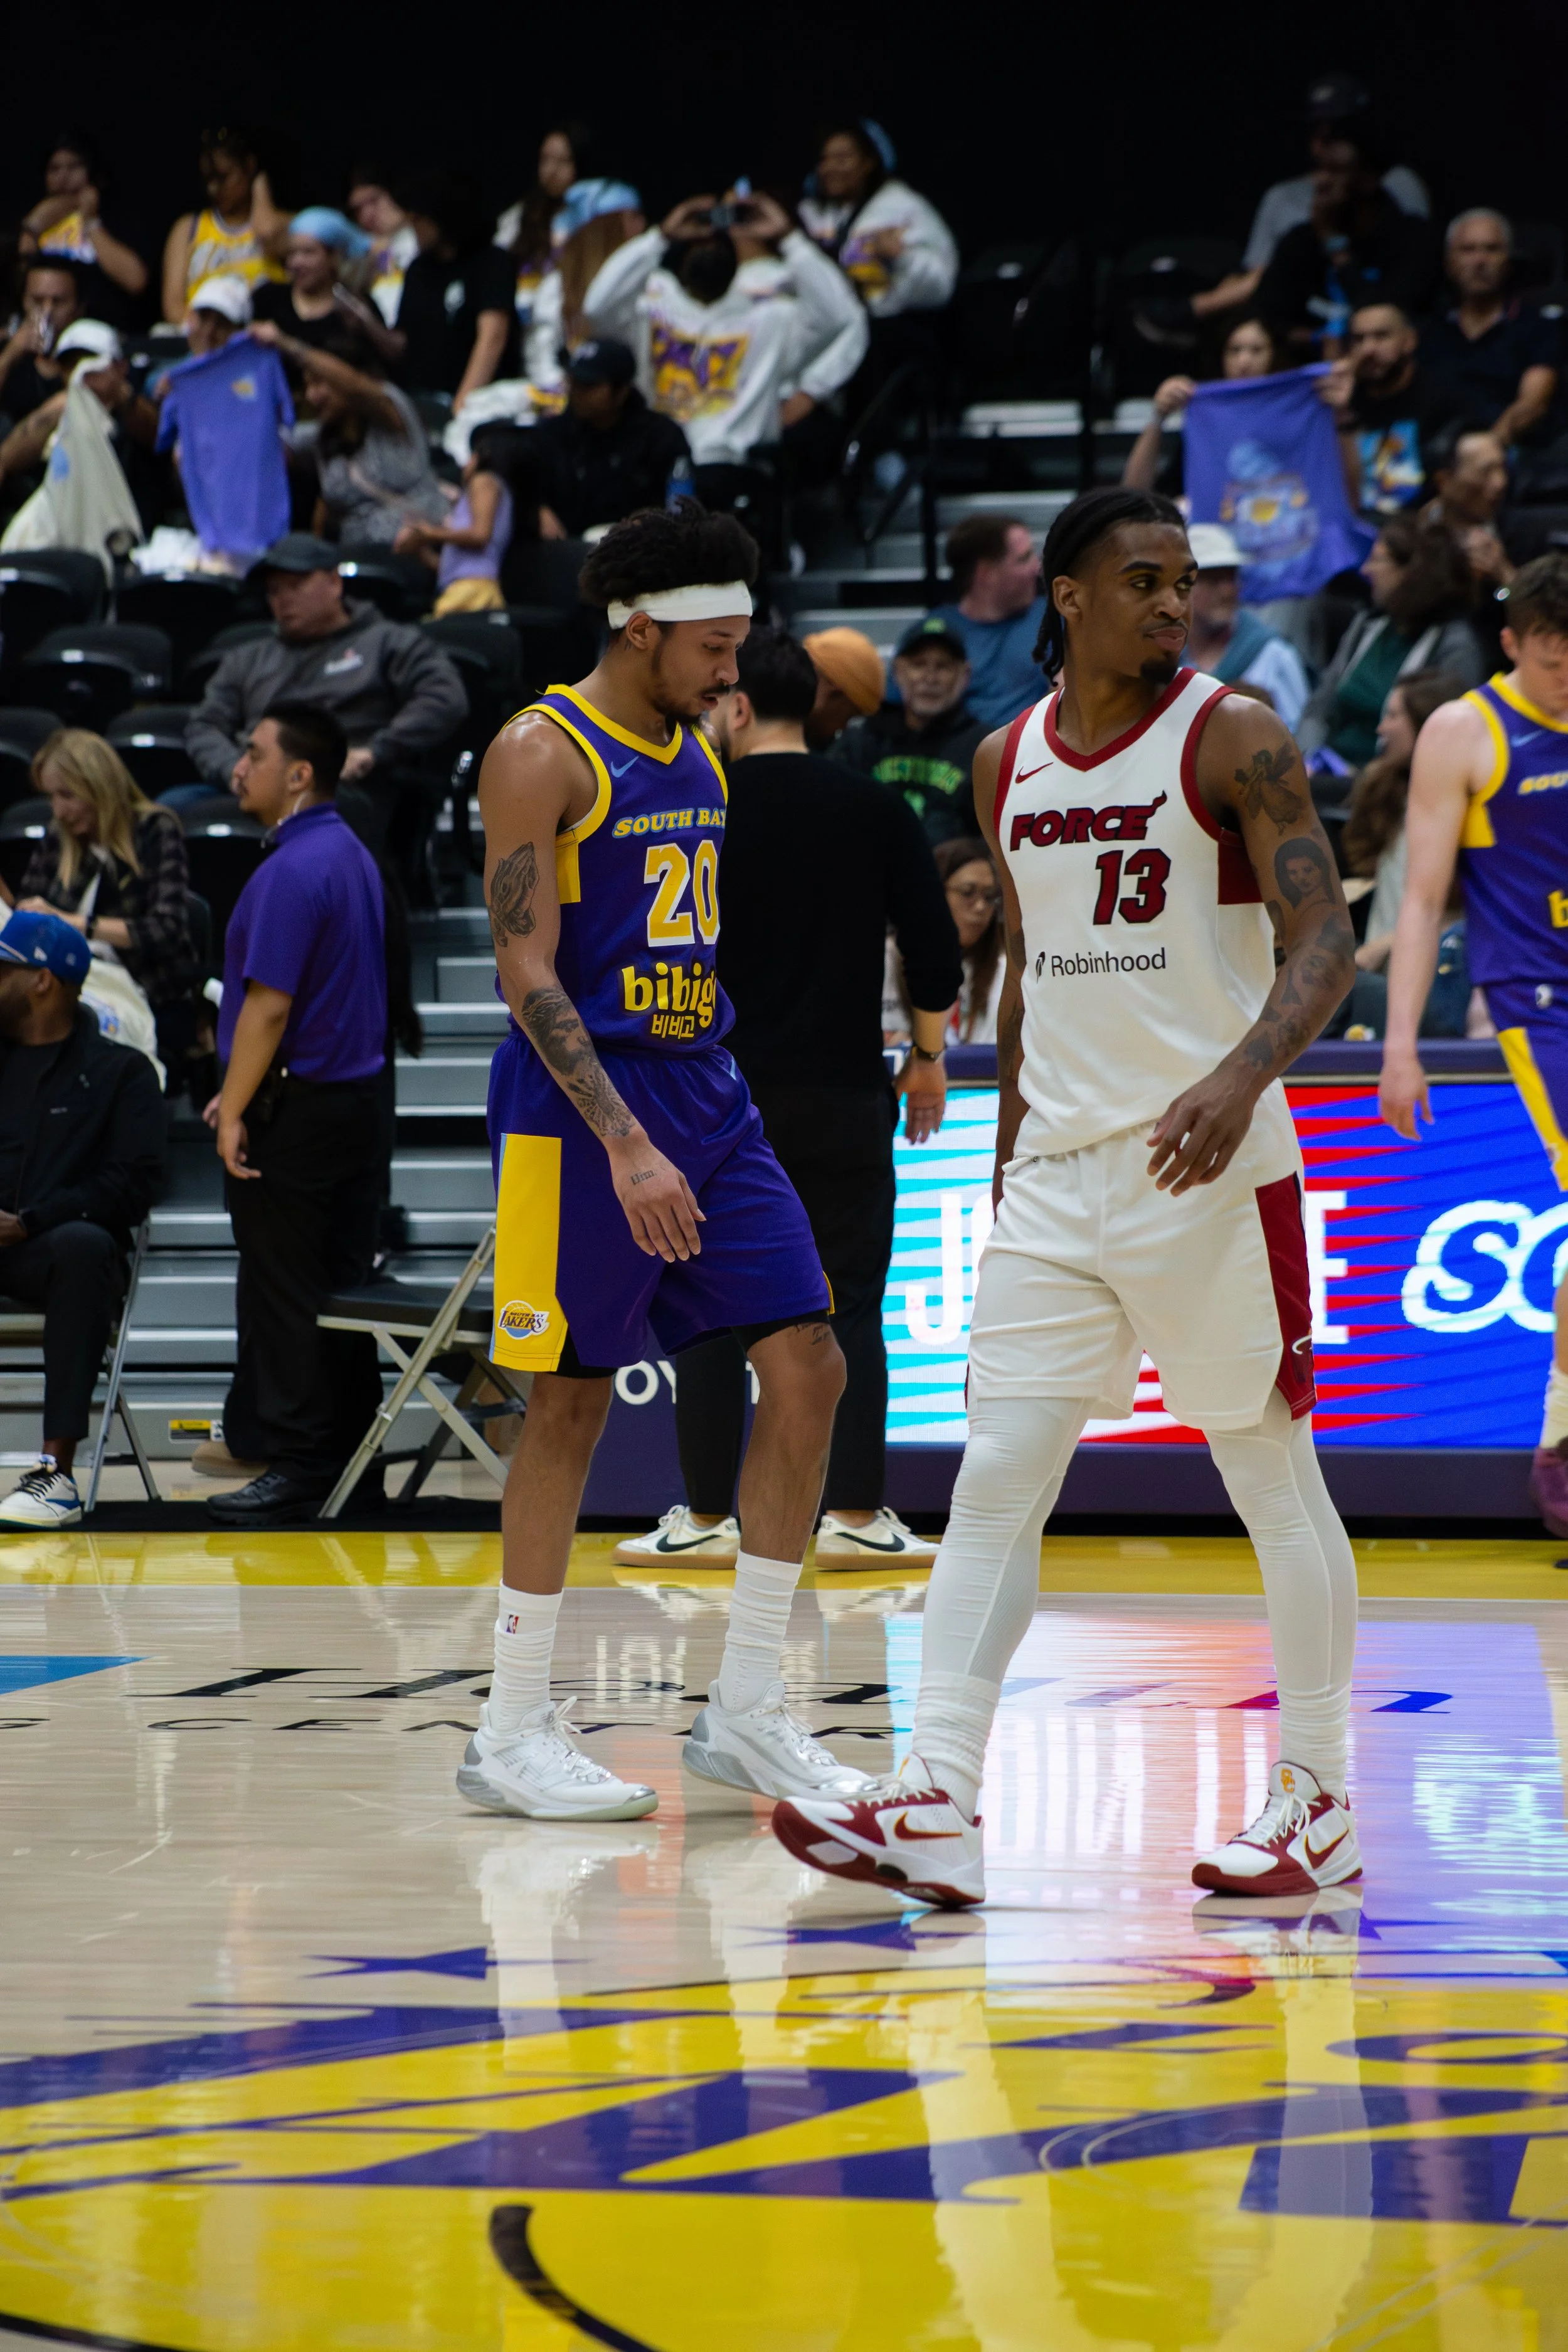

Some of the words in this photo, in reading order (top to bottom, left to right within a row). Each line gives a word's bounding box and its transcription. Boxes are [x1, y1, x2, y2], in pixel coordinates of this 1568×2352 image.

[612, 808, 694, 839] SOUTH
[1010, 792, 1167, 851] FORCE
[644, 840, 721, 948] 20
[1093, 848, 1171, 925] 13
[1051, 947, 1167, 977] Robinhood
[621, 962, 717, 1029] bibig
[651, 1014, 695, 1040] 비비고
[499, 1310, 546, 1333] LAKERS
